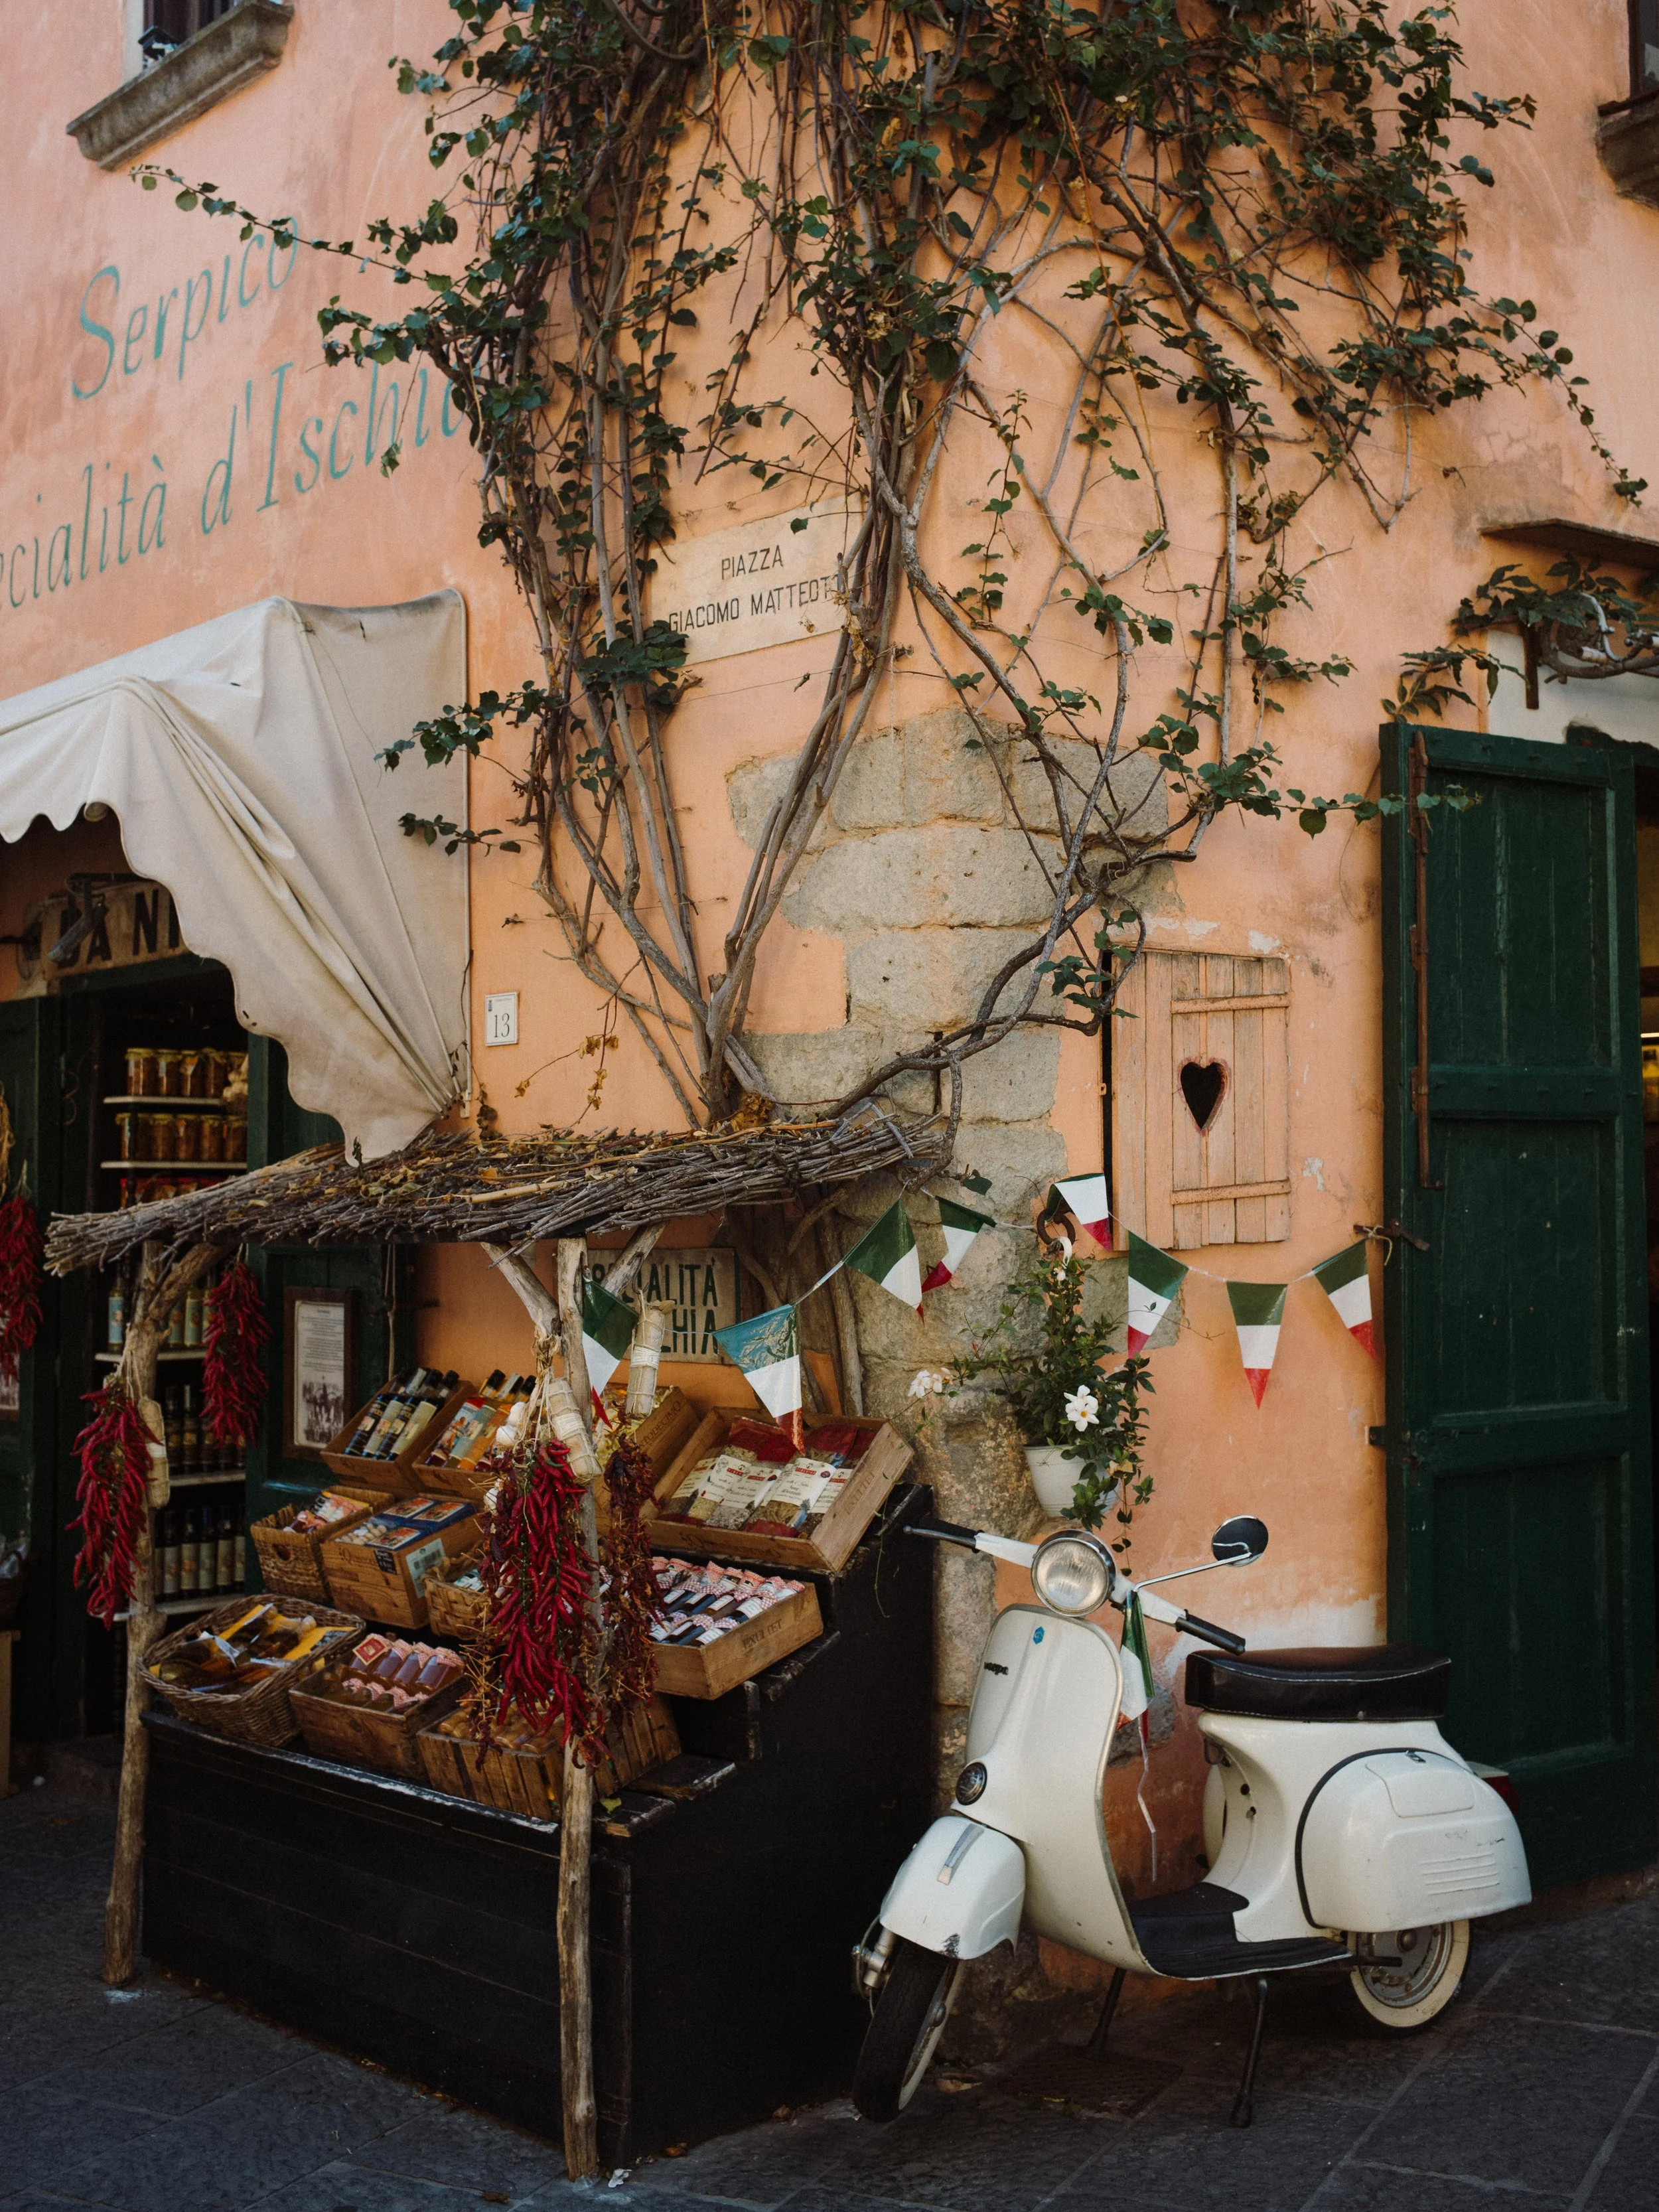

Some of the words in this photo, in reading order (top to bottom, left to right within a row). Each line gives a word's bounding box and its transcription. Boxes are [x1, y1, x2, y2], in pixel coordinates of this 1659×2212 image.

[72, 216, 298, 400] Serpico
[0, 454, 167, 609] cialità
[721, 545, 784, 580] PIAZZA
[669, 597, 739, 633] GIACOMO
[751, 573, 839, 617] MATTEOT
[494, 1013, 510, 1038] 13
